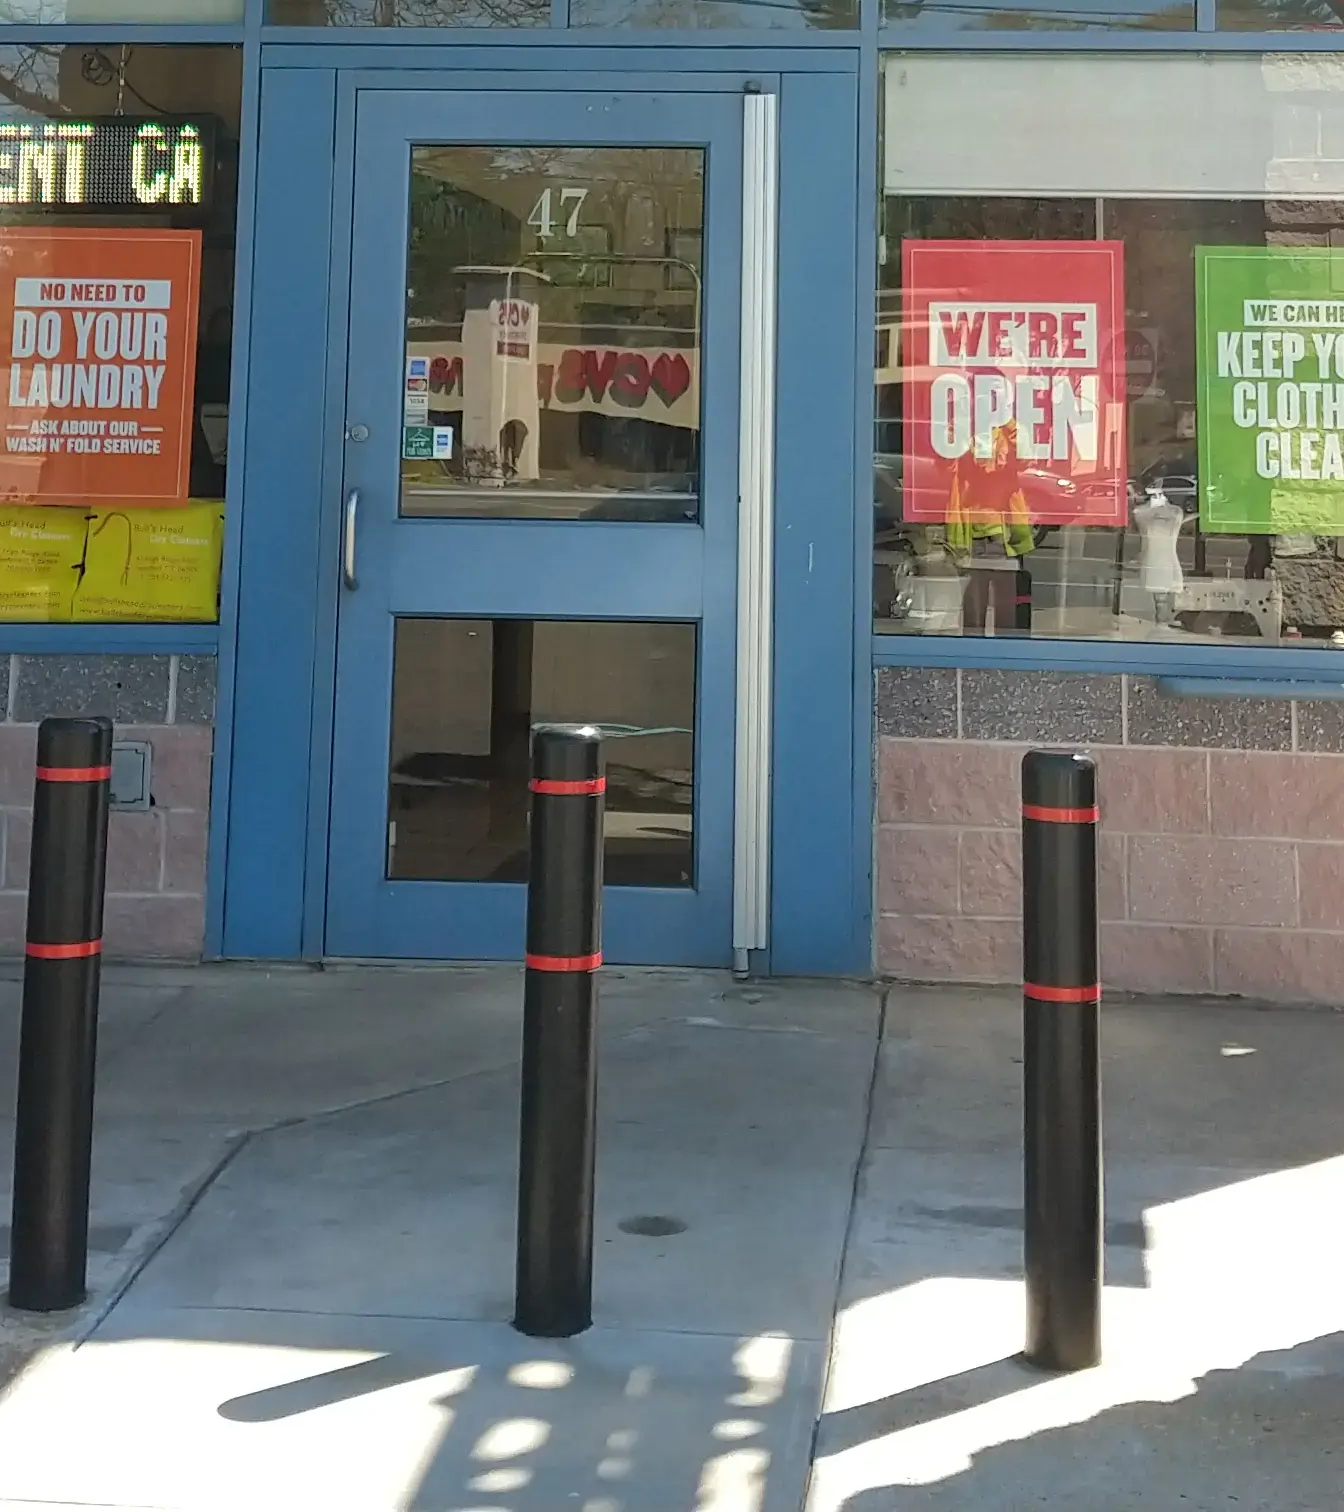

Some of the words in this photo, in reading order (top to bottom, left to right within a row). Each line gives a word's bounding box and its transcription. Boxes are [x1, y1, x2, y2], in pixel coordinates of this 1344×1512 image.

[527, 187, 588, 237] 47
[40, 283, 65, 301] NO
[70, 284, 117, 302] NEED
[122, 284, 146, 302] TO
[1250, 304, 1278, 321] WE
[1283, 305, 1320, 322] CAN
[11, 310, 62, 359] DO
[72, 311, 168, 361] YOUR
[939, 311, 1086, 358] WE'RE
[1217, 332, 1305, 378] KEEP
[9, 362, 166, 409] LAUNDRY
[30, 419, 59, 435] ASK
[61, 420, 107, 435] ABOUT
[110, 421, 138, 435] OUR
[930, 373, 1098, 461] OPEN
[7, 436, 47, 452] WASH
[67, 438, 100, 453] FOLD
[103, 439, 160, 455] SERVICE
